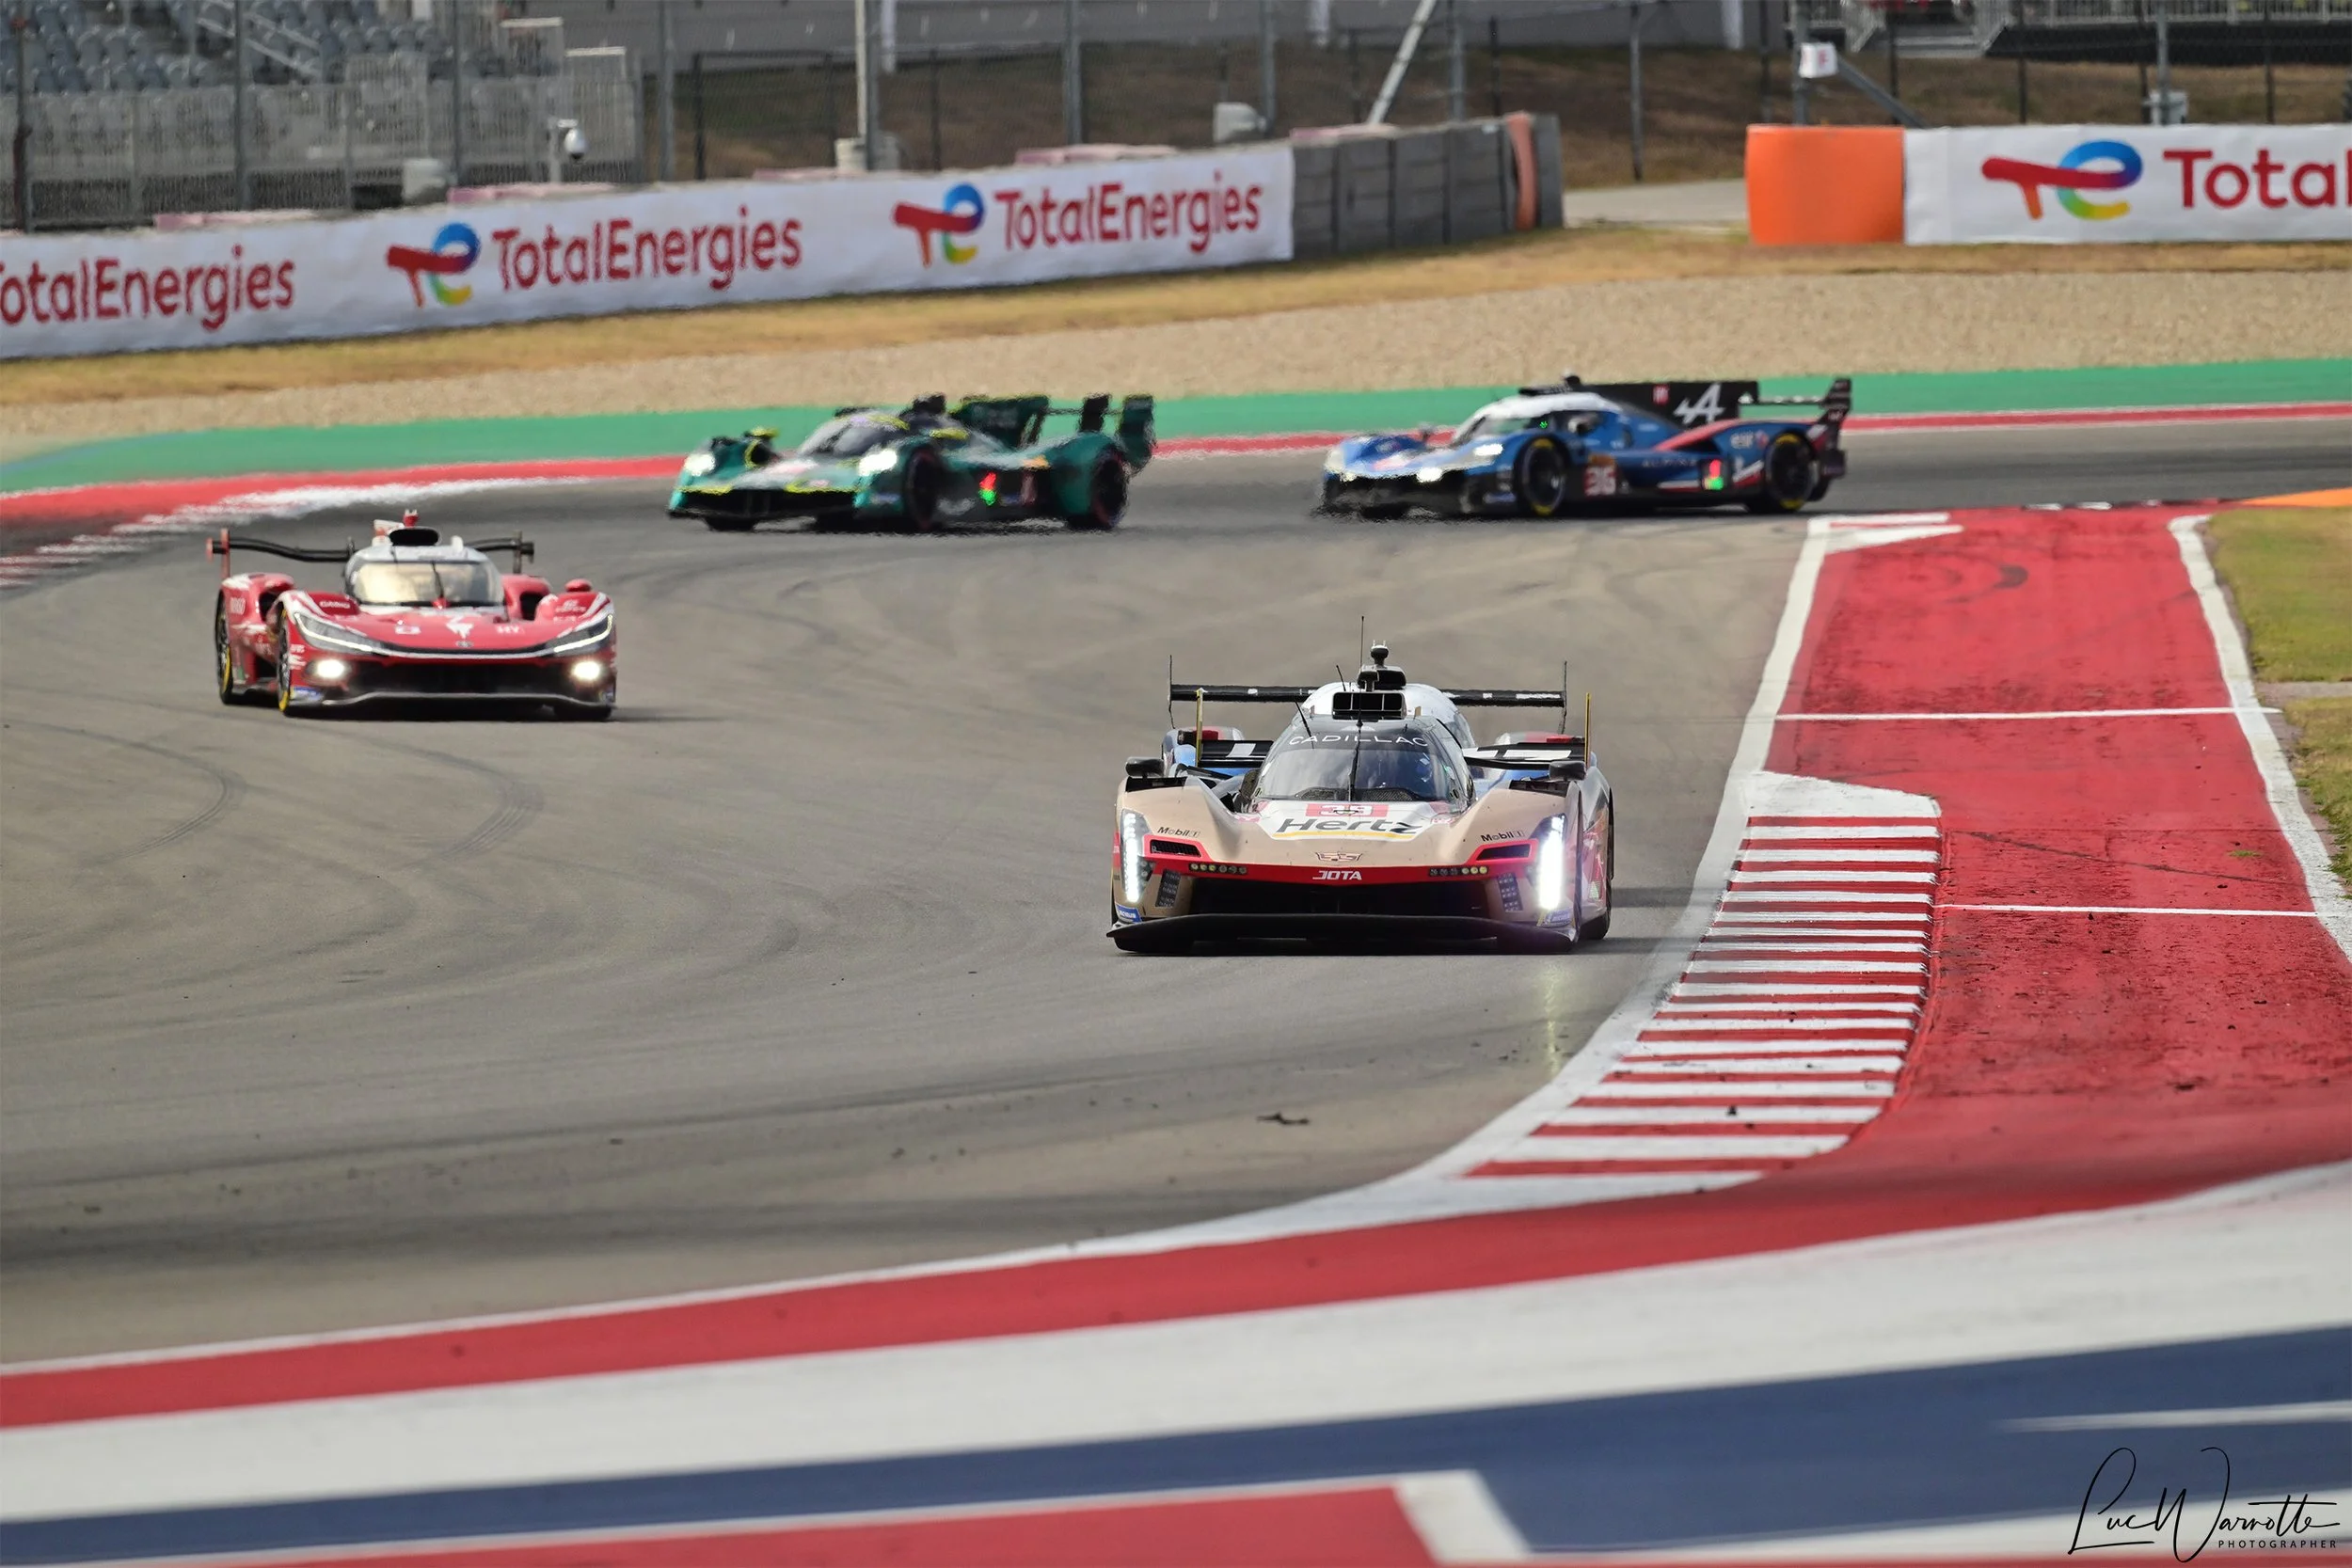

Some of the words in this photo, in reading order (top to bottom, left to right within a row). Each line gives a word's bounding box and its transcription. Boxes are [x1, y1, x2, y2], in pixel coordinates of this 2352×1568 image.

[994, 171, 1262, 254] TotalEnergies
[491, 204, 803, 291] TotalEnergies
[0, 244, 294, 330] otalEnergies
[1289, 735, 1428, 747] CADILLAC
[1157, 827, 1190, 836] Mobil
[1276, 818, 1422, 833] Hertz
[1480, 832, 1514, 842] Mobil
[1312, 870, 1362, 880] JOTA
